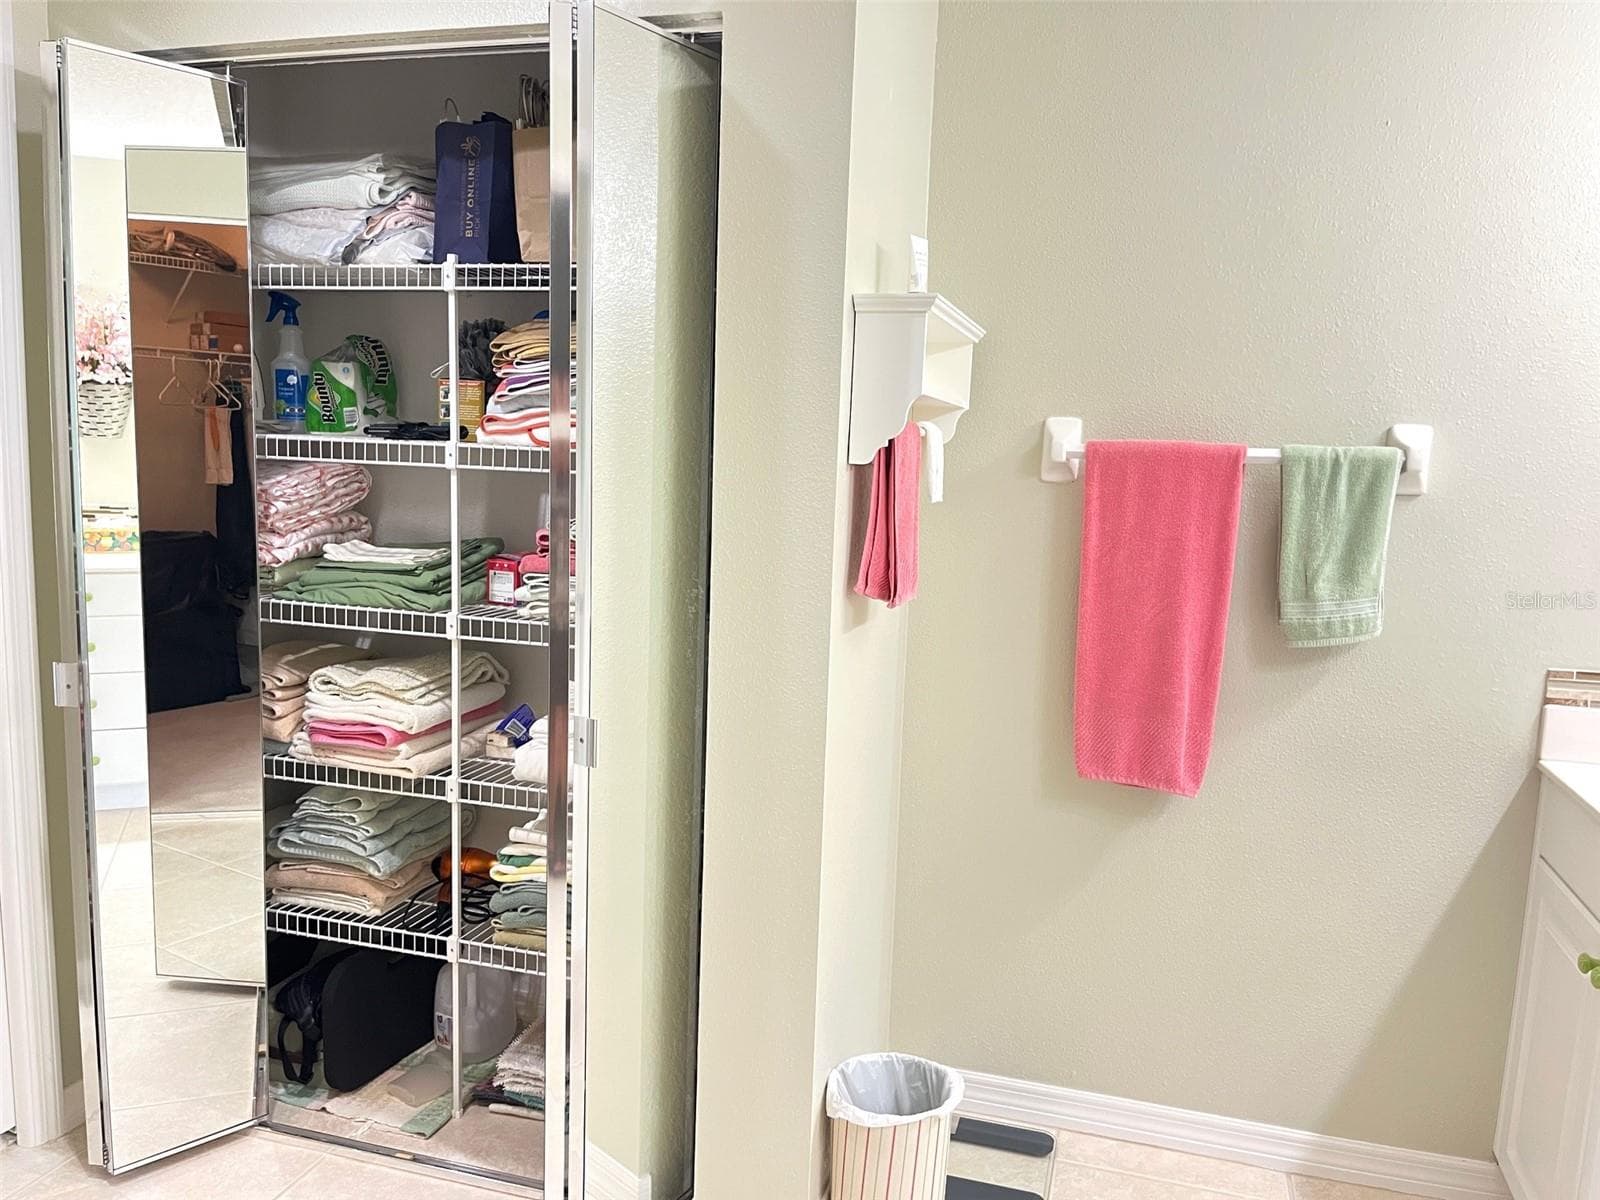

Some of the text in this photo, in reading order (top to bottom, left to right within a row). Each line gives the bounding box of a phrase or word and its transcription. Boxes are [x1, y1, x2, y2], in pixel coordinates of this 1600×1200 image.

[465, 159, 476, 238] BUY ONLINE
[313, 372, 337, 424] Bounty
